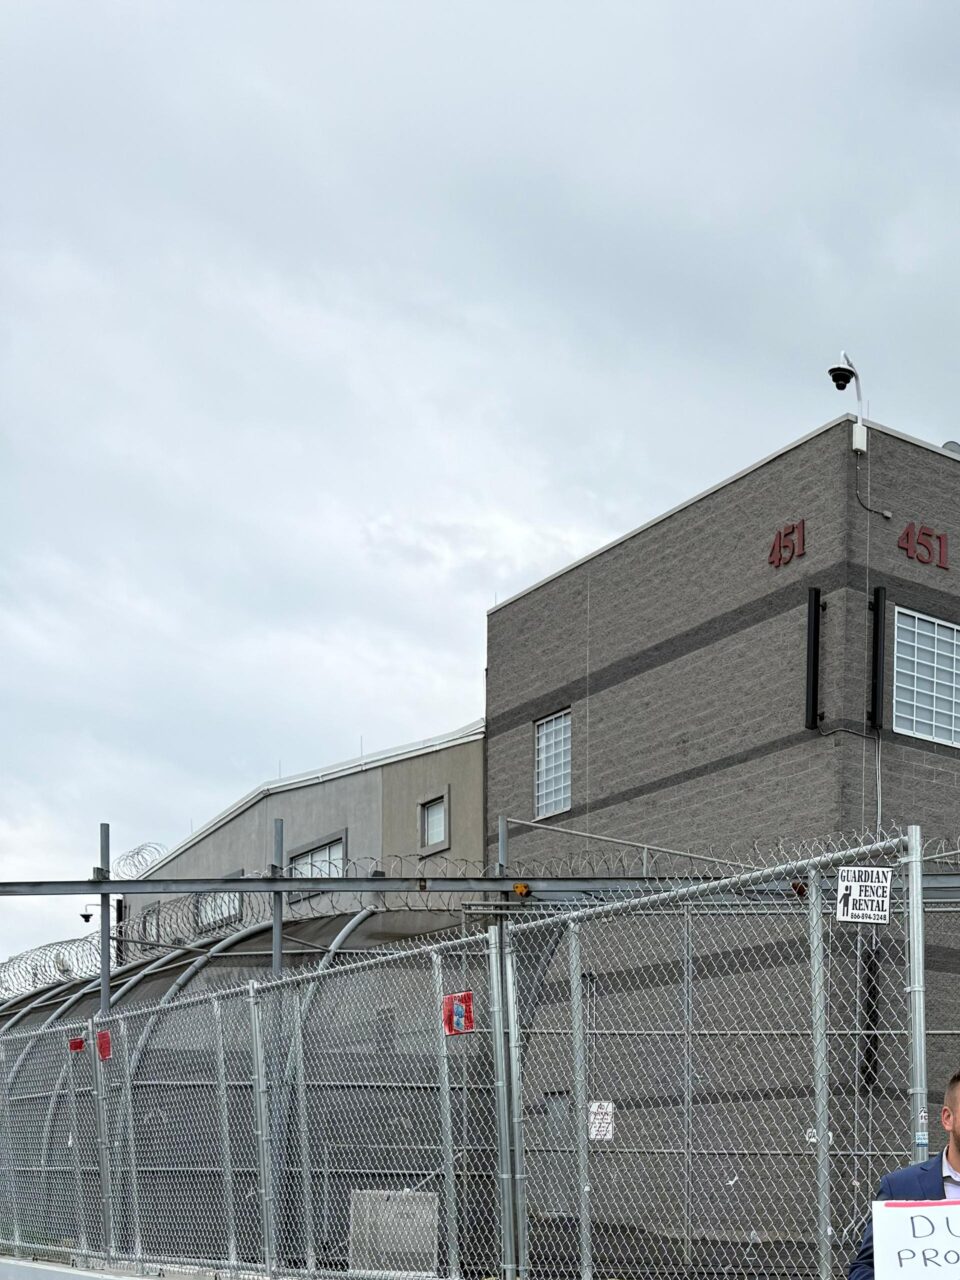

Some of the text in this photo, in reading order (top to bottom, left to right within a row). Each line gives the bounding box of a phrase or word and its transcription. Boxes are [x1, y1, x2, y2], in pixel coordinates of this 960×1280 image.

[768, 519, 806, 568] 451
[897, 522, 949, 570] 451
[840, 869, 889, 883] GUARDIAN
[858, 885, 887, 898] FENCE
[852, 899, 886, 912] RENTAL
[850, 913, 886, 921] 866-894-3248
